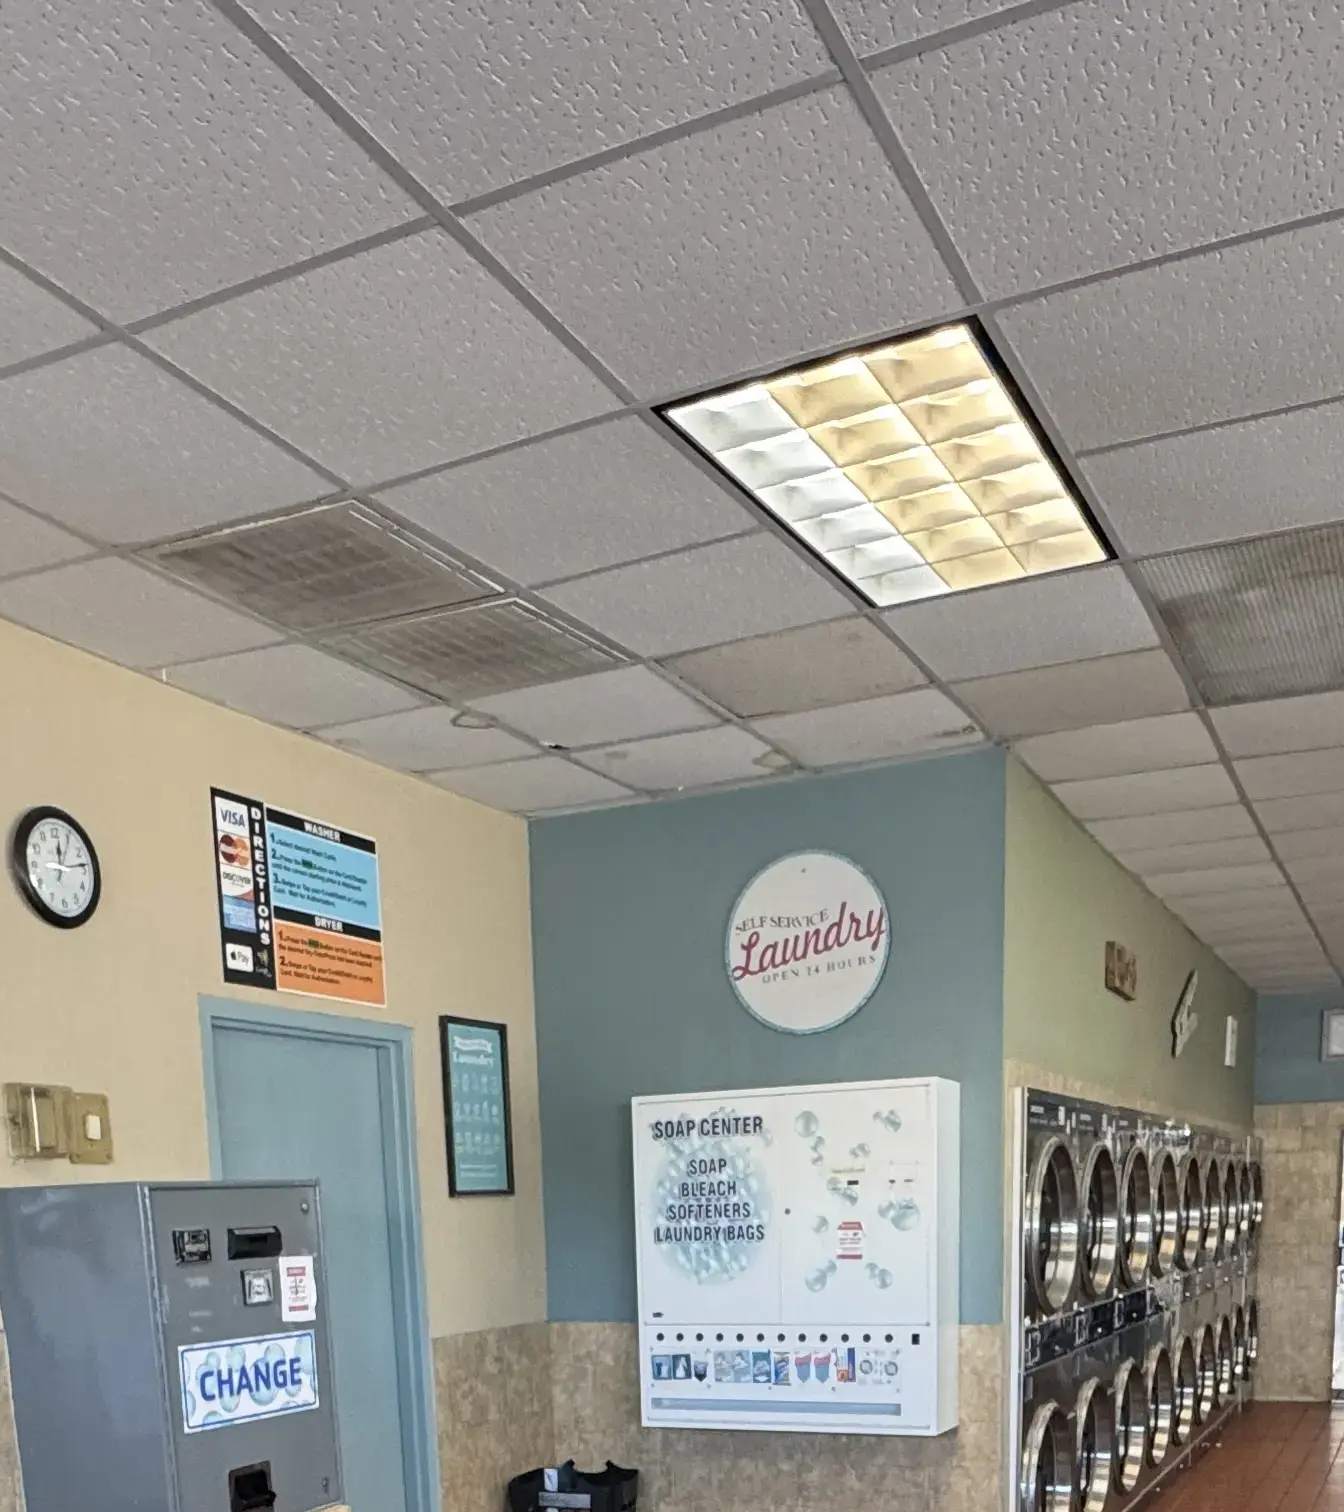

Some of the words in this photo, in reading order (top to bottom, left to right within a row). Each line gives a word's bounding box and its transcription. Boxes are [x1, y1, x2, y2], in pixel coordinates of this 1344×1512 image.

[220, 807, 246, 829] VISA
[304, 821, 341, 843] WASHER
[251, 806, 271, 945] DIRECTIONS
[314, 916, 344, 933] DRYER
[735, 916, 769, 933] SELF
[770, 908, 830, 928] SERVICE
[731, 901, 887, 982] Laundry
[762, 969, 801, 984] OPEN
[826, 955, 876, 973] HOURS
[654, 1120, 696, 1140] SOAP
[700, 1116, 763, 1137] CENTER
[689, 1158, 727, 1175] SOAP
[681, 1180, 737, 1197] BLEACH
[668, 1202, 751, 1220] SOFTENERS
[656, 1226, 721, 1243] LAUNDRY
[727, 1225, 765, 1241] BAGS
[199, 1355, 302, 1402] CHANGE
